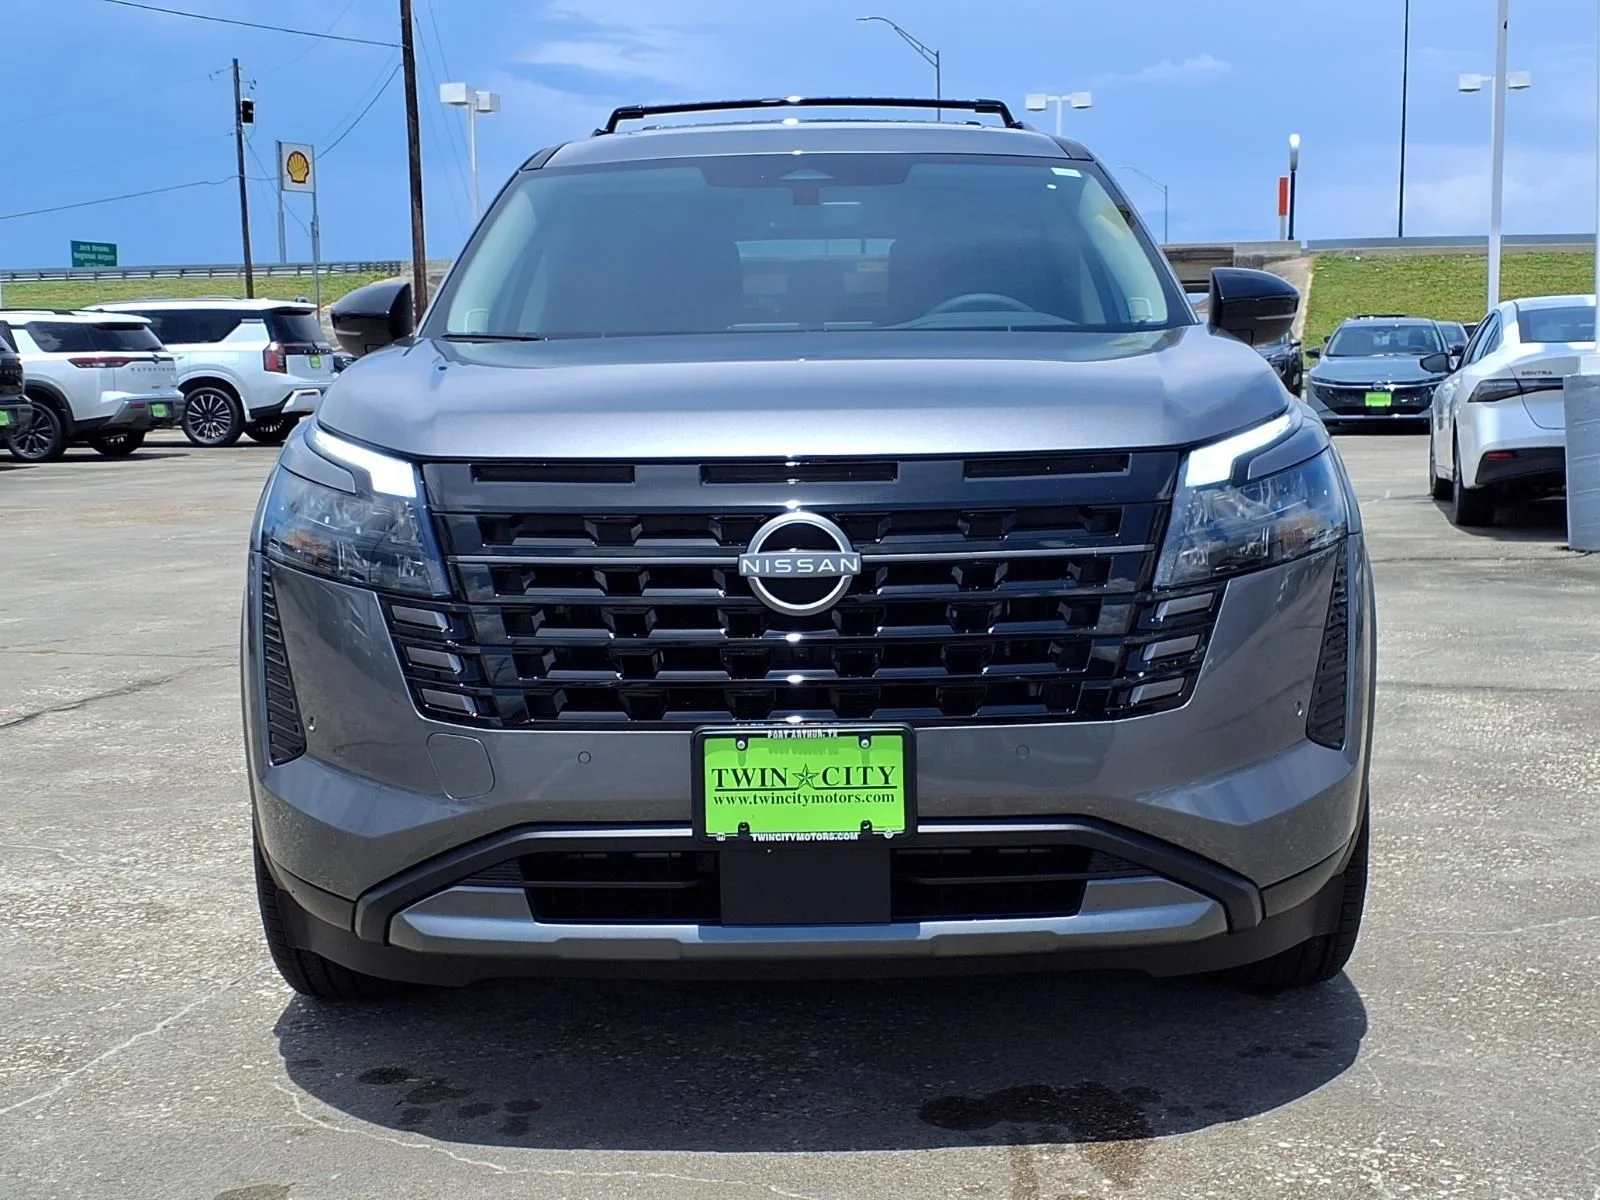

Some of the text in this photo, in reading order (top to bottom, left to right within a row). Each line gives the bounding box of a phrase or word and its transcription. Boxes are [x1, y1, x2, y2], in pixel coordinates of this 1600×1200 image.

[742, 557, 858, 573] NISSAN
[767, 730, 789, 739] PORT
[827, 729, 838, 738] TX
[711, 765, 896, 788] TWIN CITY
[713, 791, 895, 807] www.twincitymotors.com
[751, 832, 859, 842] TWINCITYMOTORS.COM
